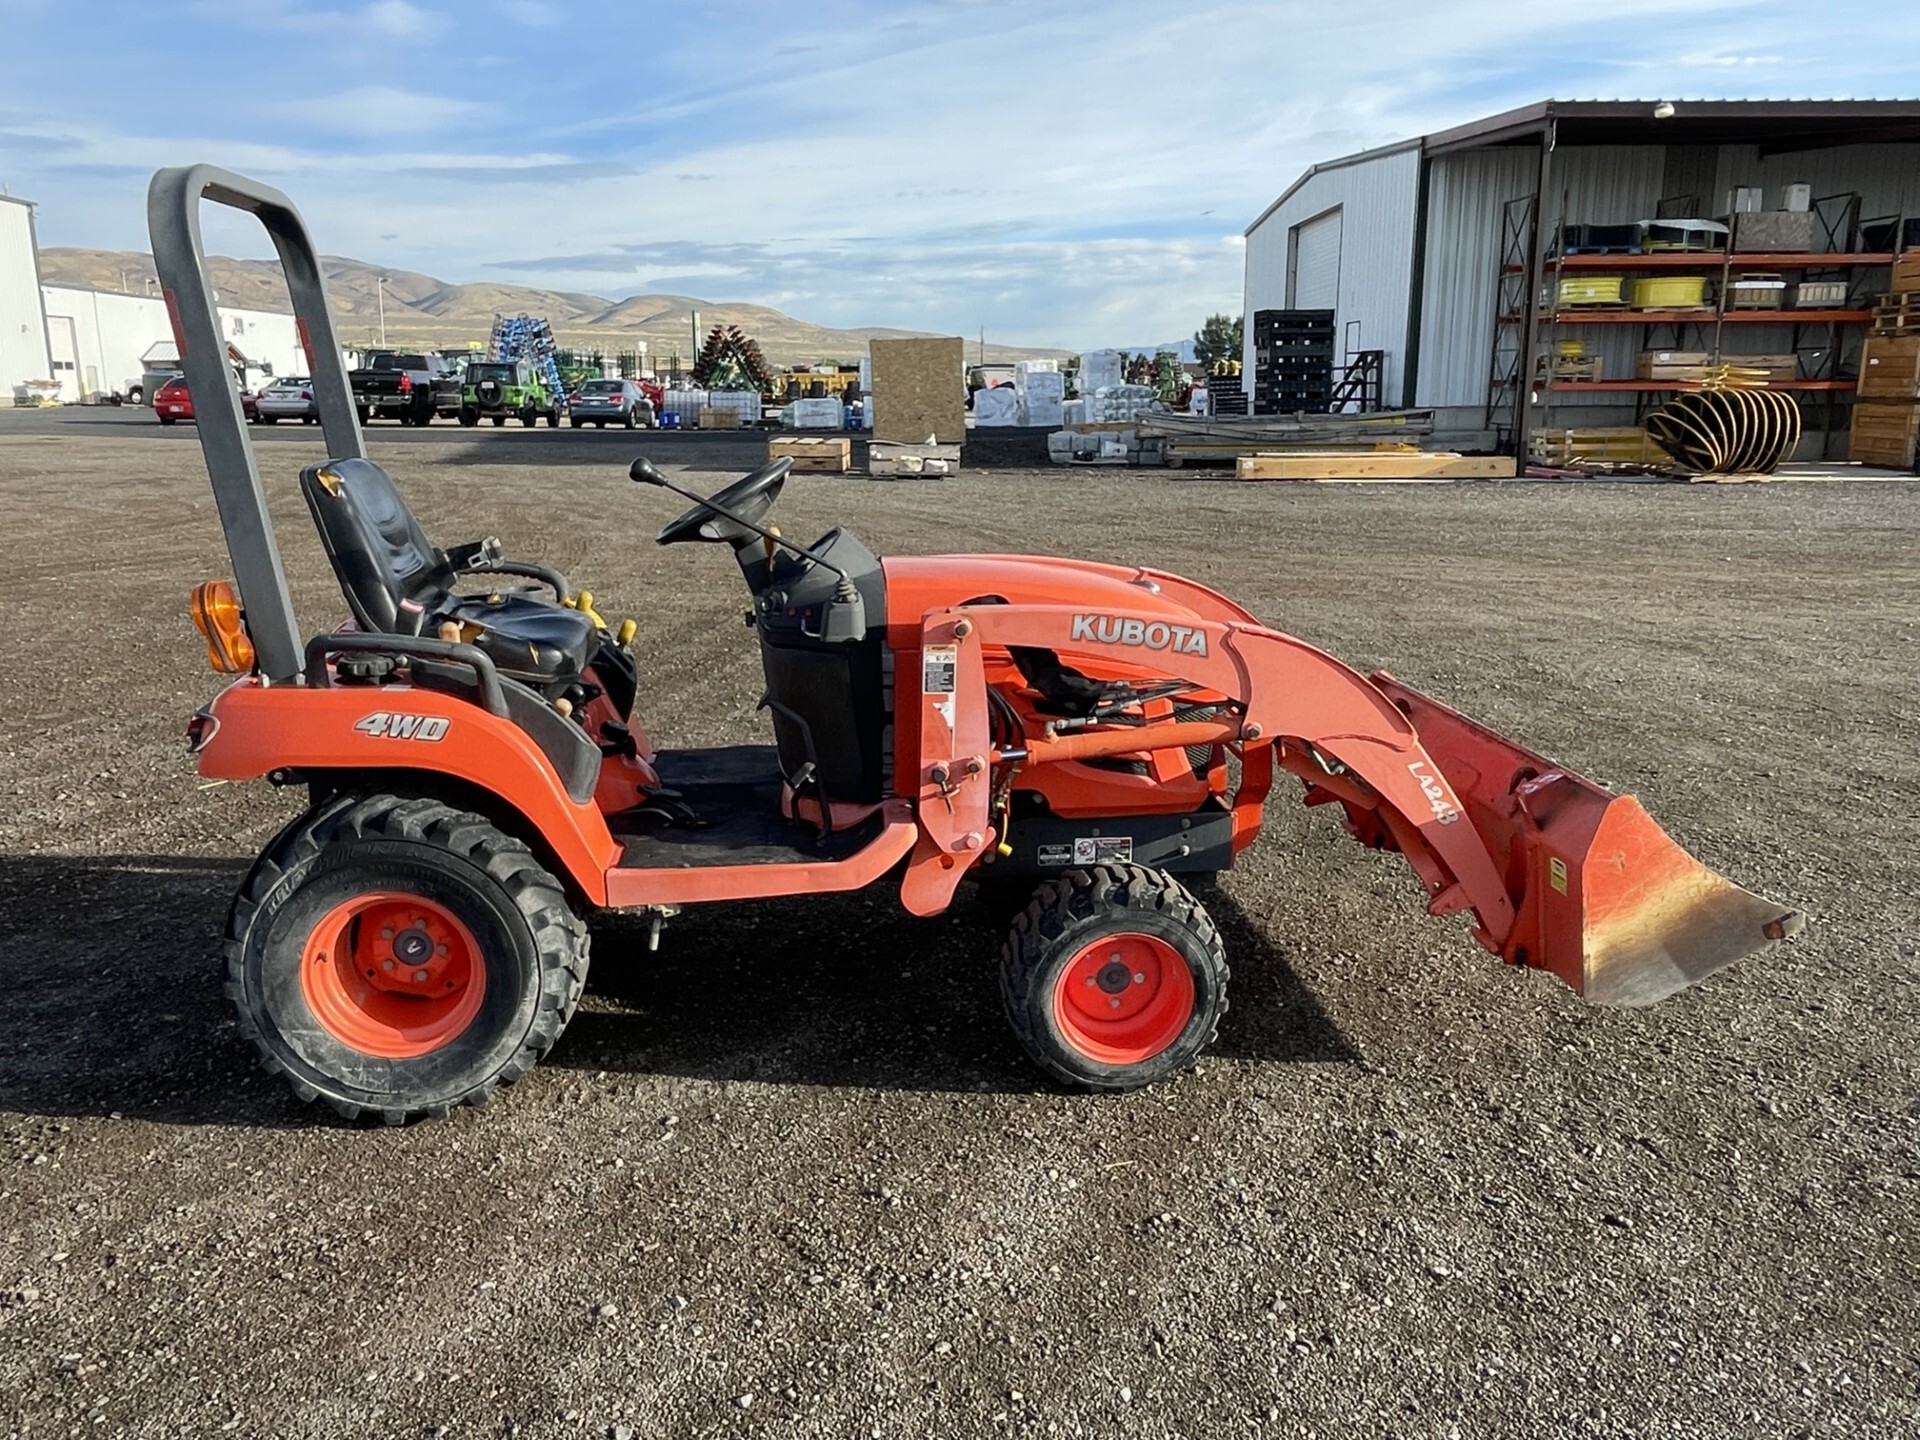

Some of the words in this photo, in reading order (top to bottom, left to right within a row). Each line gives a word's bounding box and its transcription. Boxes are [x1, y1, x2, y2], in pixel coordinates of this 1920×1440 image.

[1071, 613, 1208, 657] KUBOTA
[354, 711, 451, 741] 4WD
[1406, 761, 1459, 825] LA243
